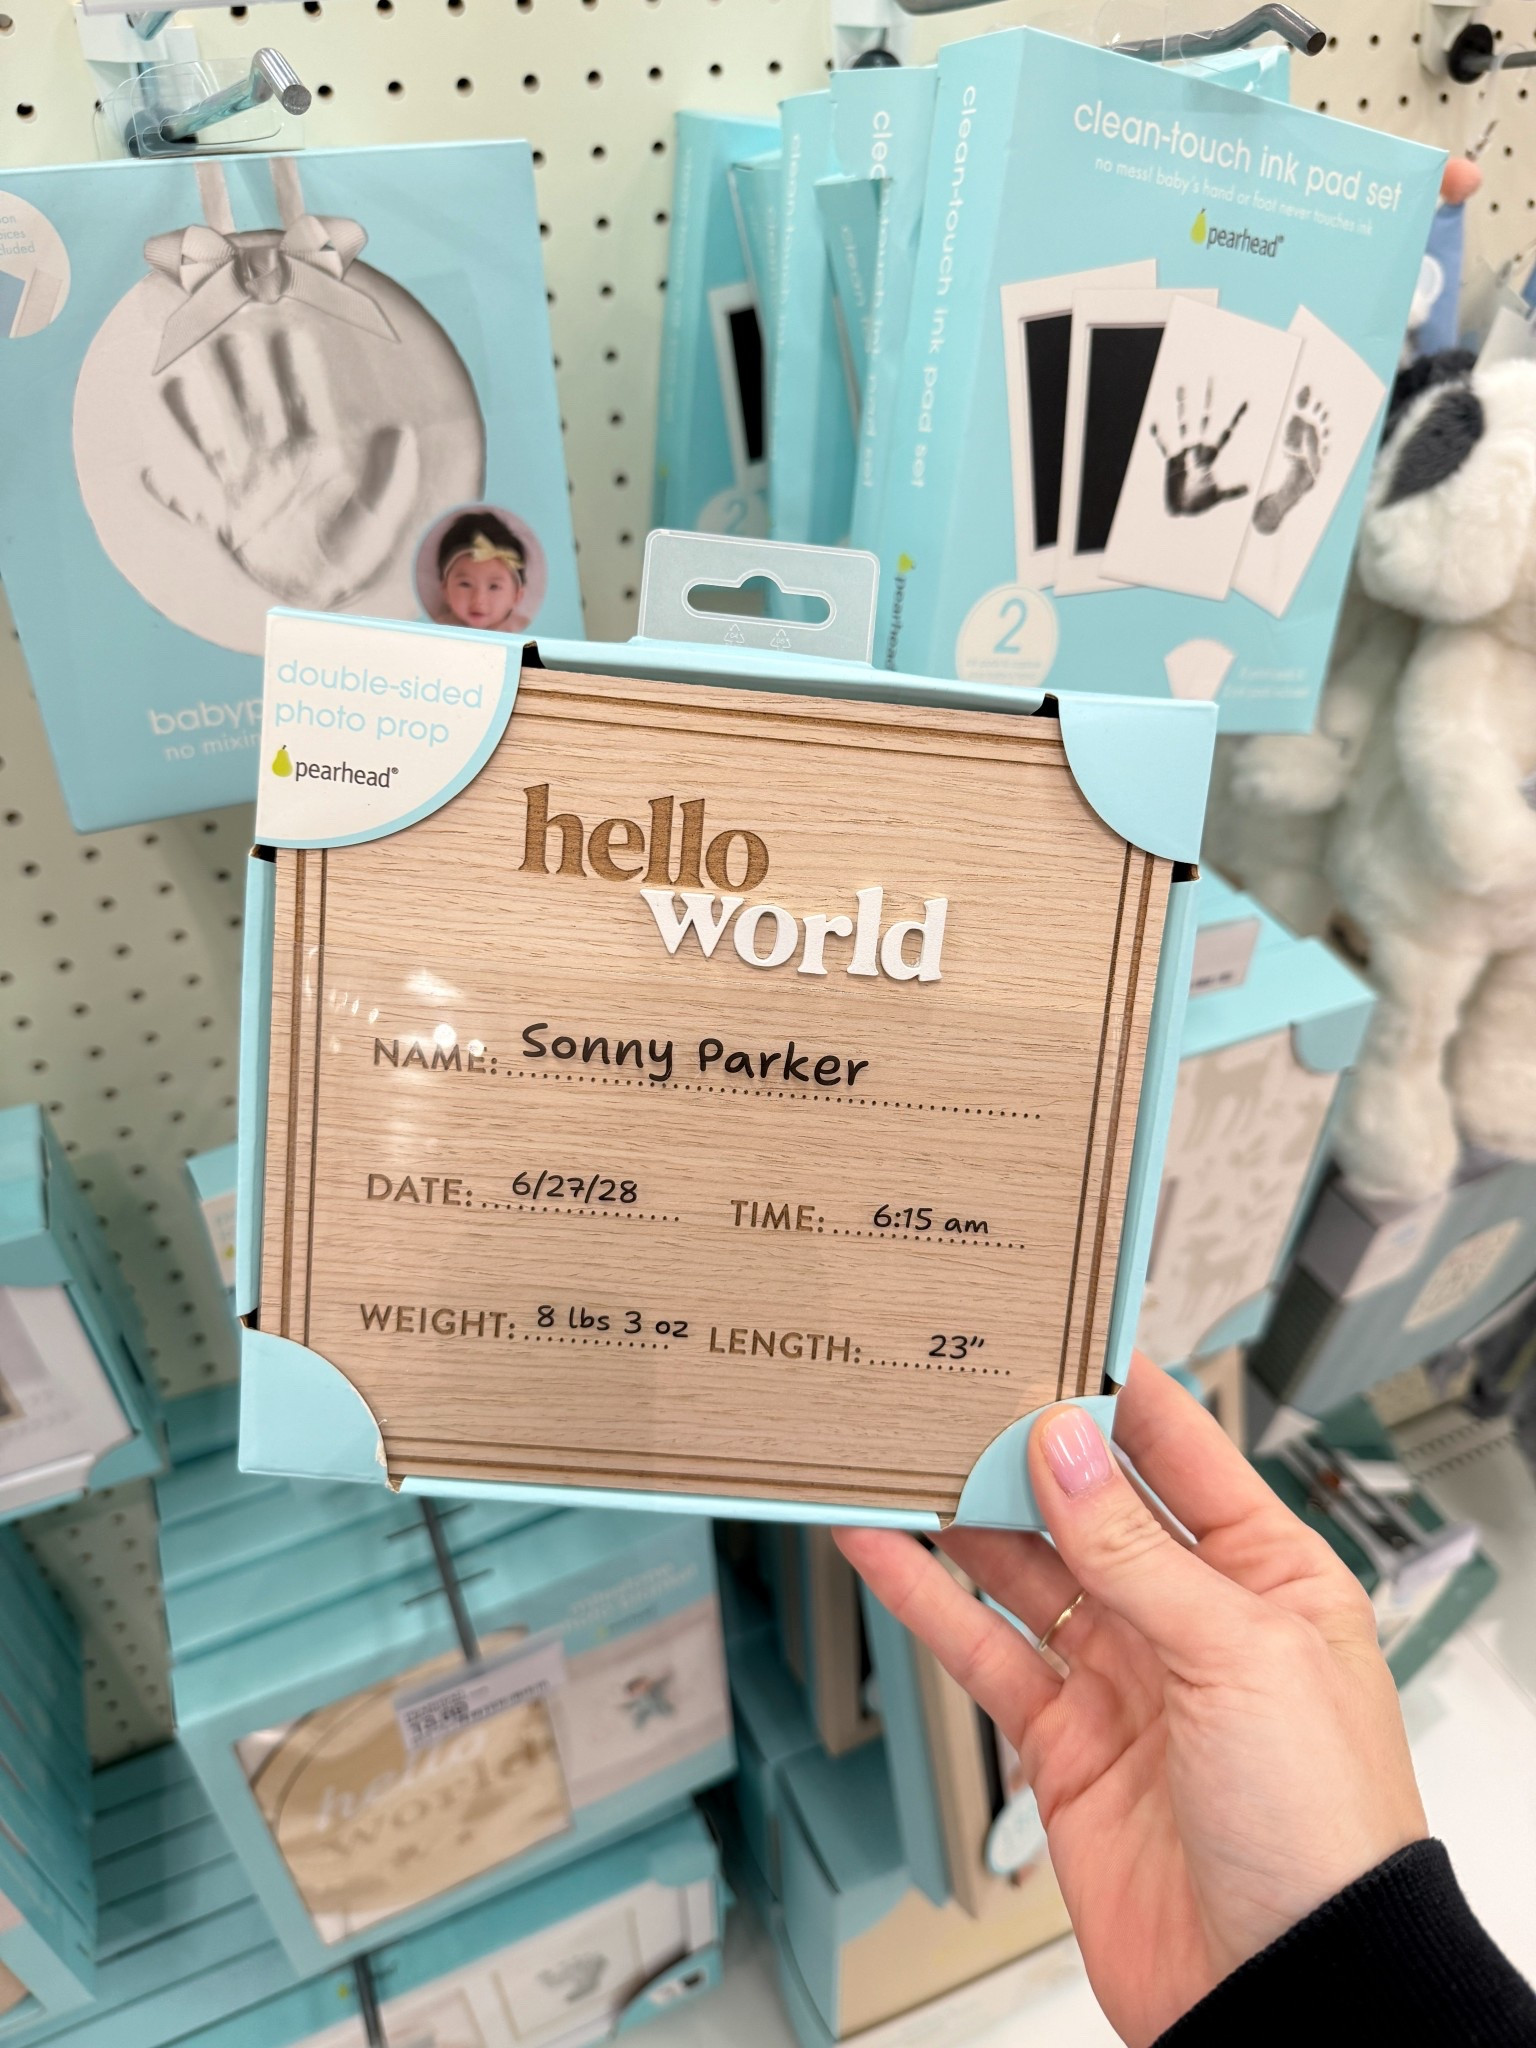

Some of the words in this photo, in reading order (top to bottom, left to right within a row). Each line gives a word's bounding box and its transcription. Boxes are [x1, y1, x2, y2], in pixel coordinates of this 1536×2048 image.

[1073, 100, 1252, 173] clean-touch
[1259, 145, 1298, 186] ink
[1305, 165, 1363, 202] pad
[1365, 181, 1403, 213] set
[1095, 157, 1113, 174] no
[1155, 169, 1201, 197] baby's
[1202, 179, 1234, 204] hand
[936, 85, 977, 296] clean-touch
[927, 307, 948, 354] ink
[917, 365, 939, 433] pad
[911, 444, 929, 489] set
[993, 598, 1028, 654] 2
[276, 659, 483, 709] double-sided
[274, 700, 366, 732] photo
[376, 715, 450, 748] prop
[164, 745, 195, 762] no
[518, 784, 769, 892] hello
[640, 886, 948, 982] world
[521, 1022, 673, 1082] Sonny
[699, 1037, 869, 1087] Parker
[367, 1173, 473, 1207] DATE:
[511, 1169, 638, 1204] 6/27/28
[731, 1199, 825, 1233] TIME:
[873, 1204, 933, 1231] 6:15
[944, 1217, 989, 1234] am
[360, 1303, 515, 1340] WEIGHT:
[537, 1305, 555, 1328] 8
[569, 1306, 610, 1331] lbs
[624, 1311, 642, 1334] 3
[655, 1320, 689, 1338] oz
[709, 1326, 861, 1364] LENGTH:
